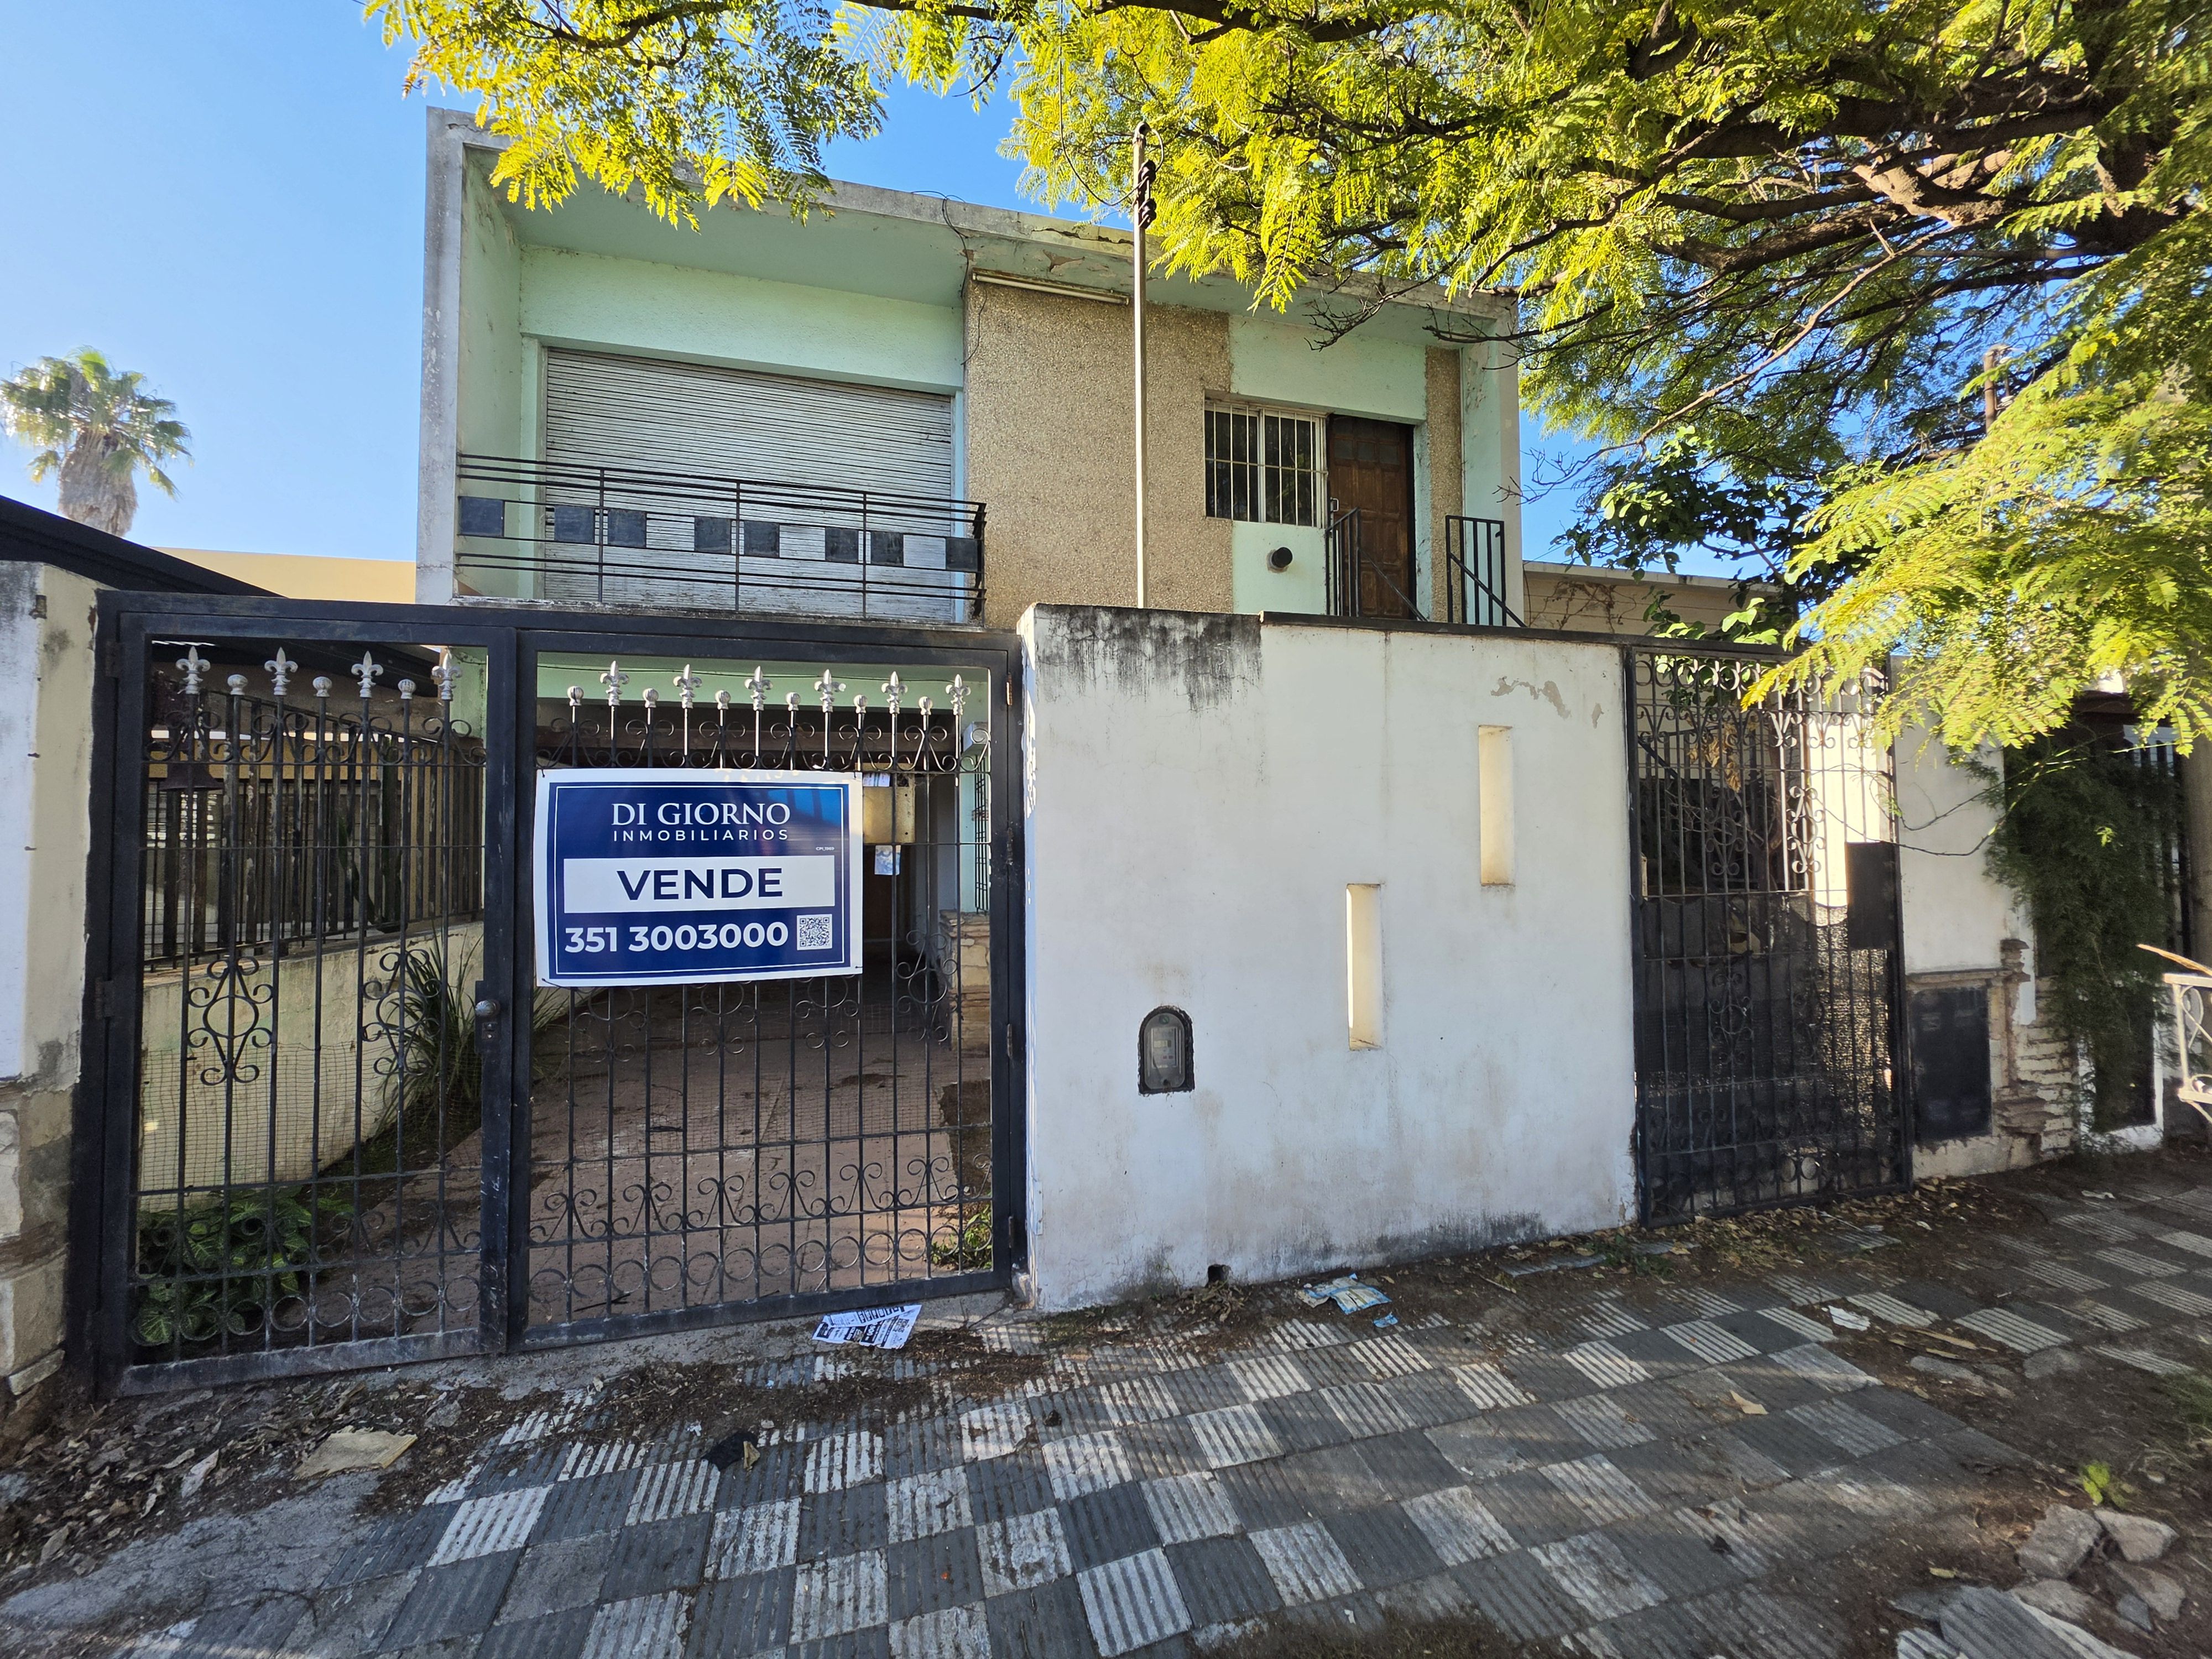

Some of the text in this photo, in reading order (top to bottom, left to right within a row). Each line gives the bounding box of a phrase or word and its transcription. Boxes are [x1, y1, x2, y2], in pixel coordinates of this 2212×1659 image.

[612, 802, 791, 826] DI GIORNO
[614, 828, 789, 842] INMOBILIARIOS
[616, 868, 783, 901] VENDE
[565, 921, 789, 953] 351 3003000
